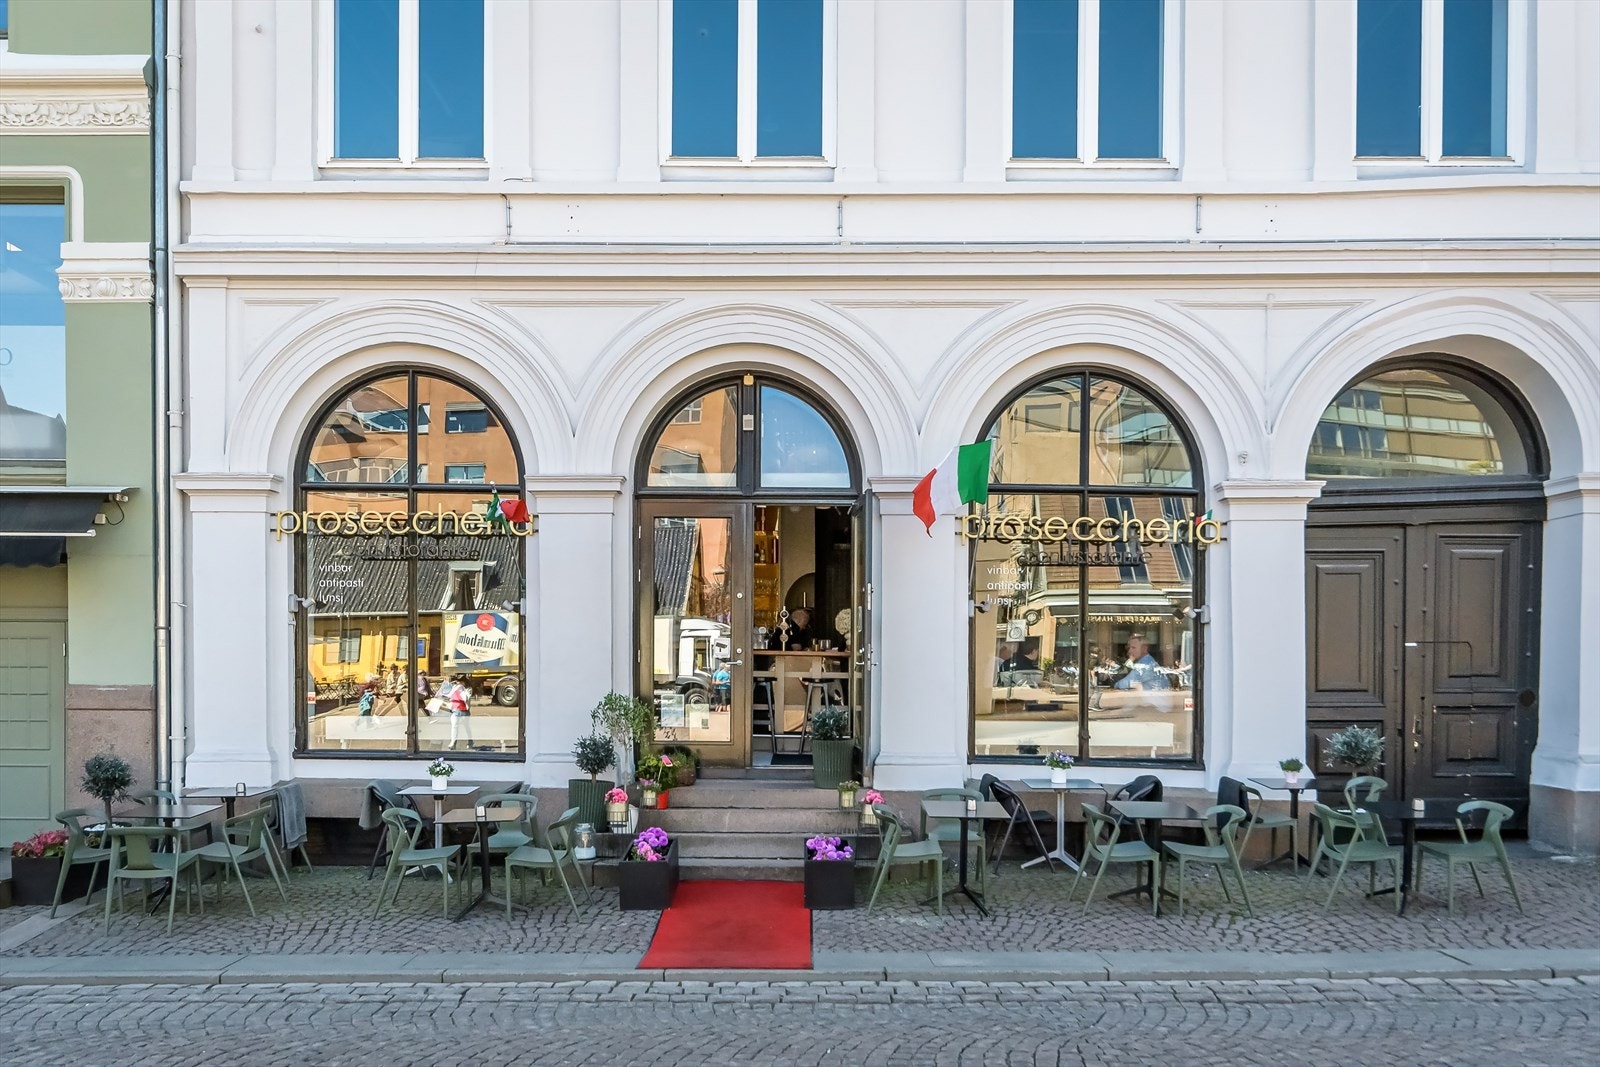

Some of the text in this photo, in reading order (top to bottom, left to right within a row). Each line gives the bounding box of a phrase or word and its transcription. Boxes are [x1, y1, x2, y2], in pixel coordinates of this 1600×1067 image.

[961, 510, 1222, 546] proseccheria
[319, 561, 352, 572] vinbar
[987, 564, 1024, 575] vinbar
[319, 577, 364, 590] antipasti
[987, 580, 1033, 592] antipasti
[319, 591, 344, 604] lunsj
